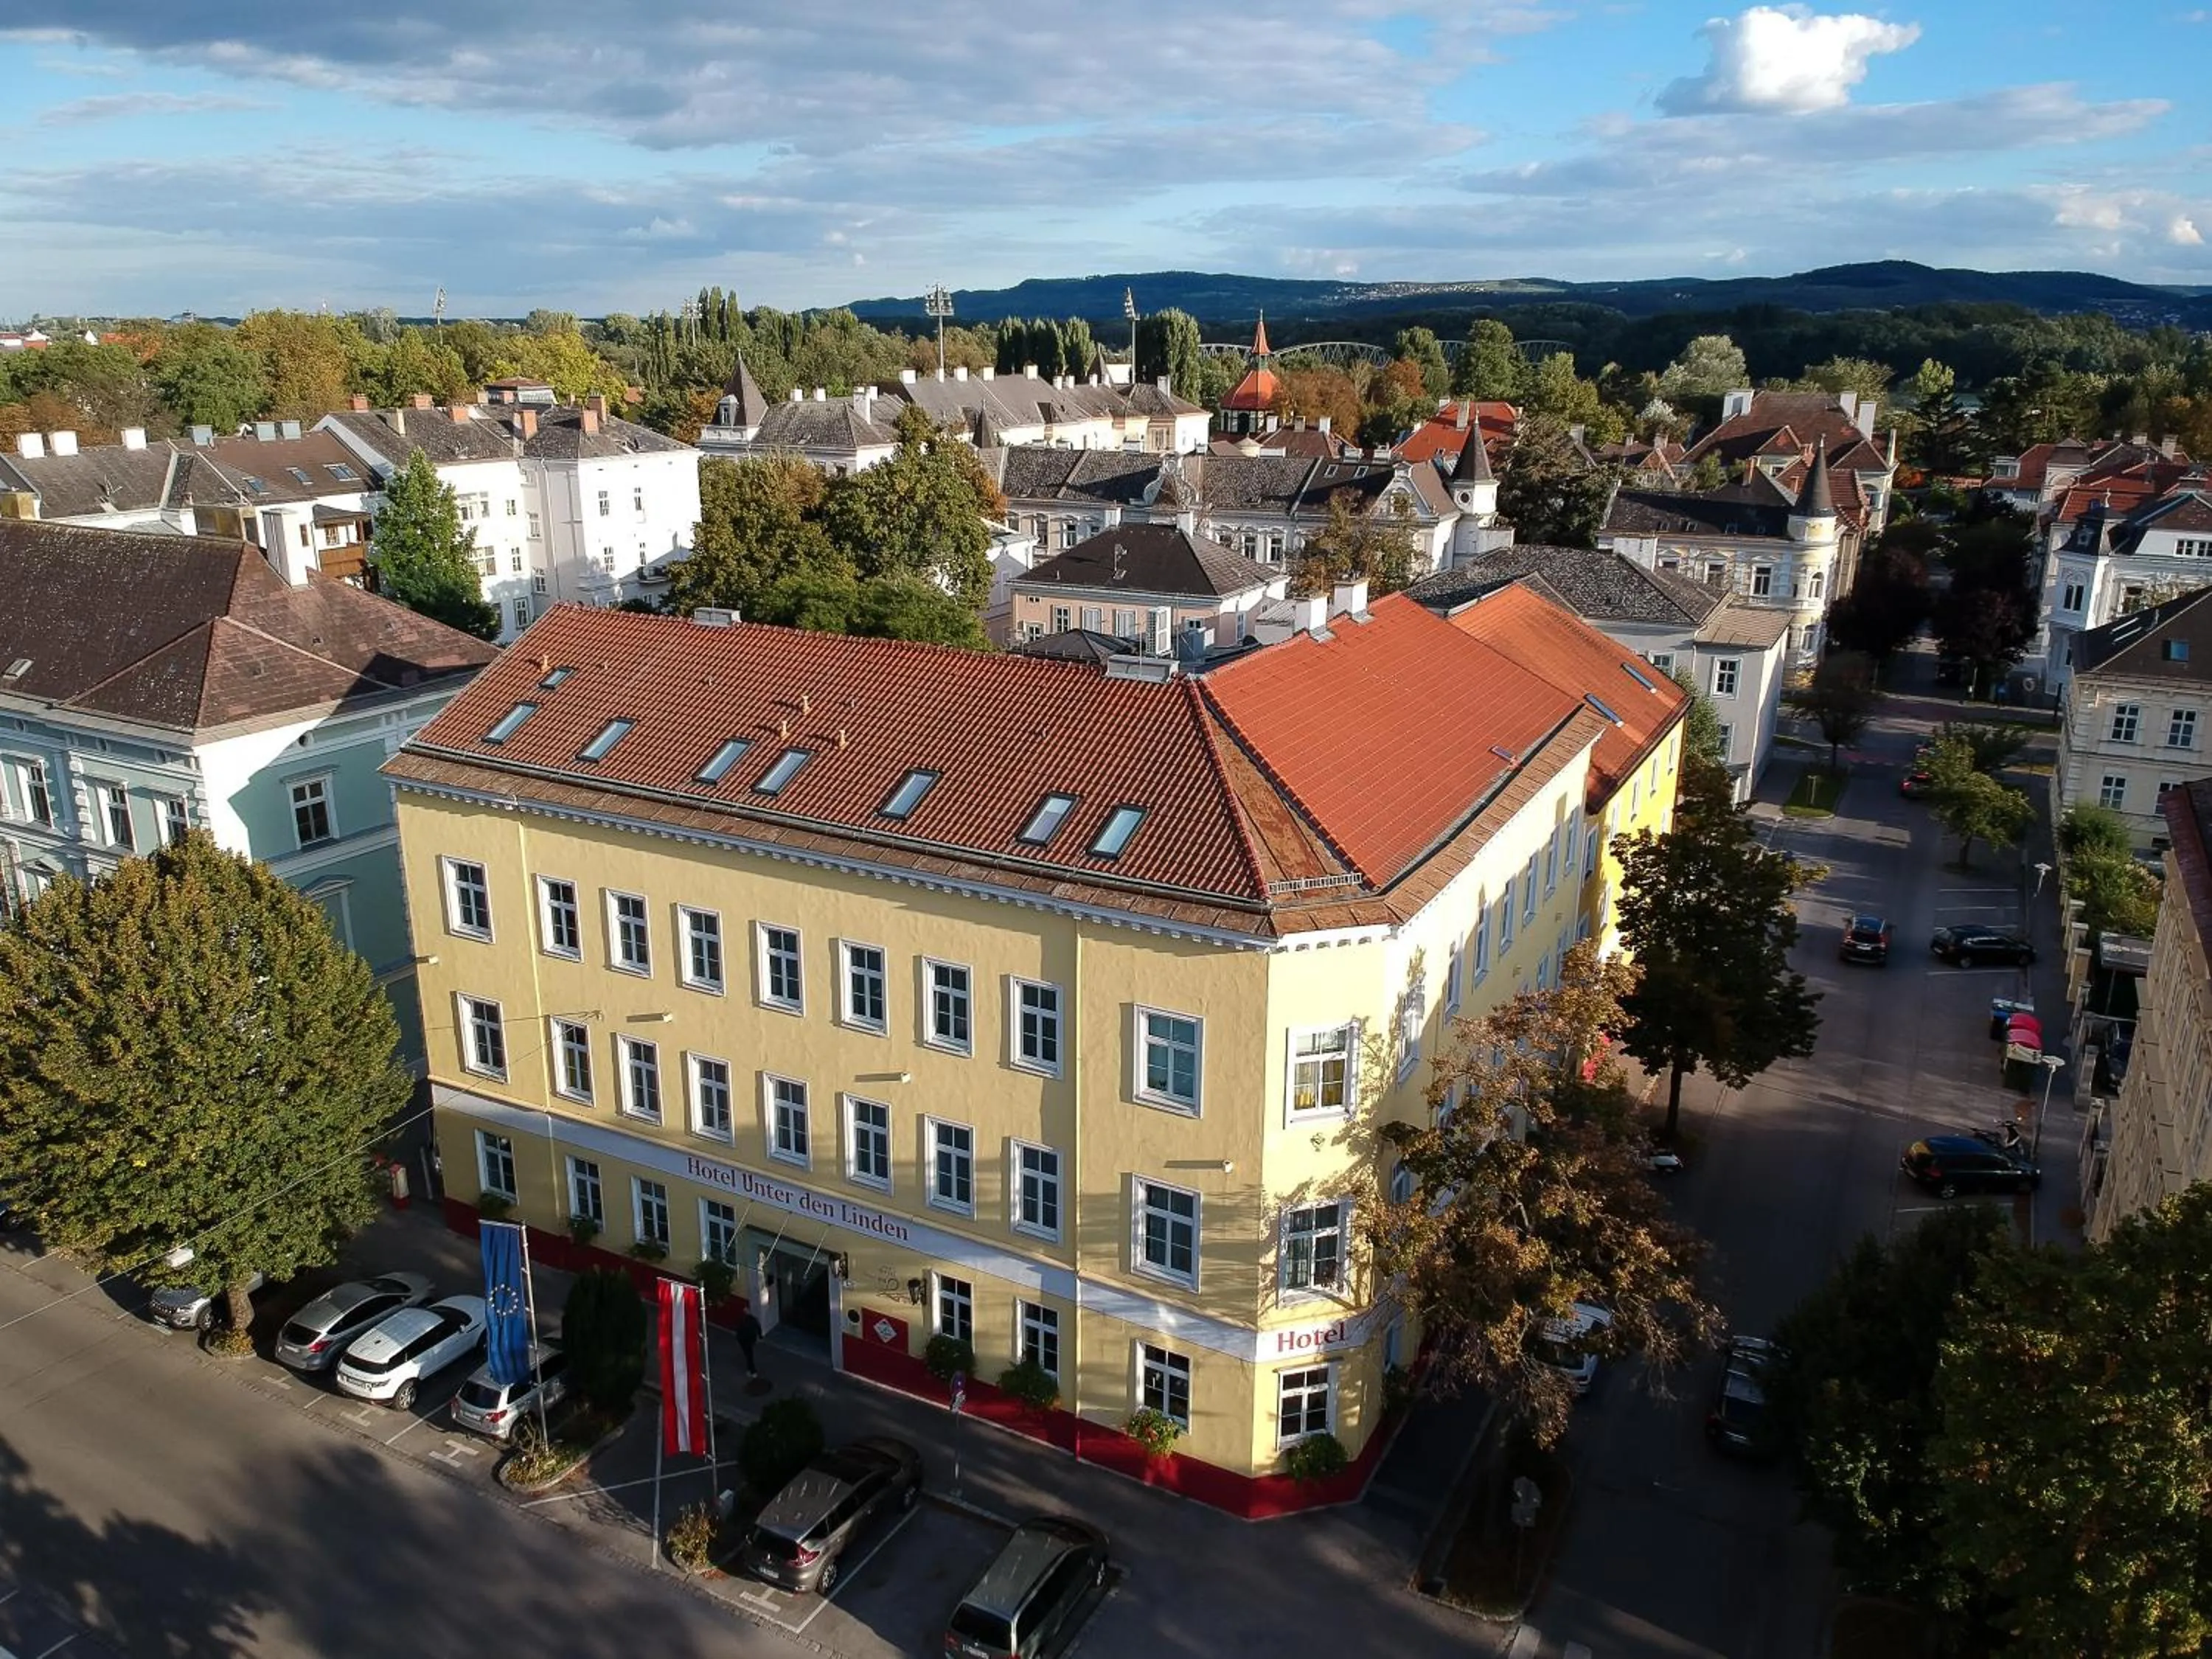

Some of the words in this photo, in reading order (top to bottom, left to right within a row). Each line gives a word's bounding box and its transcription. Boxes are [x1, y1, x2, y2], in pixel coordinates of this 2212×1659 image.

[688, 1157, 736, 1188] Hotel
[742, 1173, 794, 1204] Unter
[799, 1193, 835, 1217] den
[842, 1204, 909, 1241] Linden
[1278, 1321, 1346, 1352] Hotel
